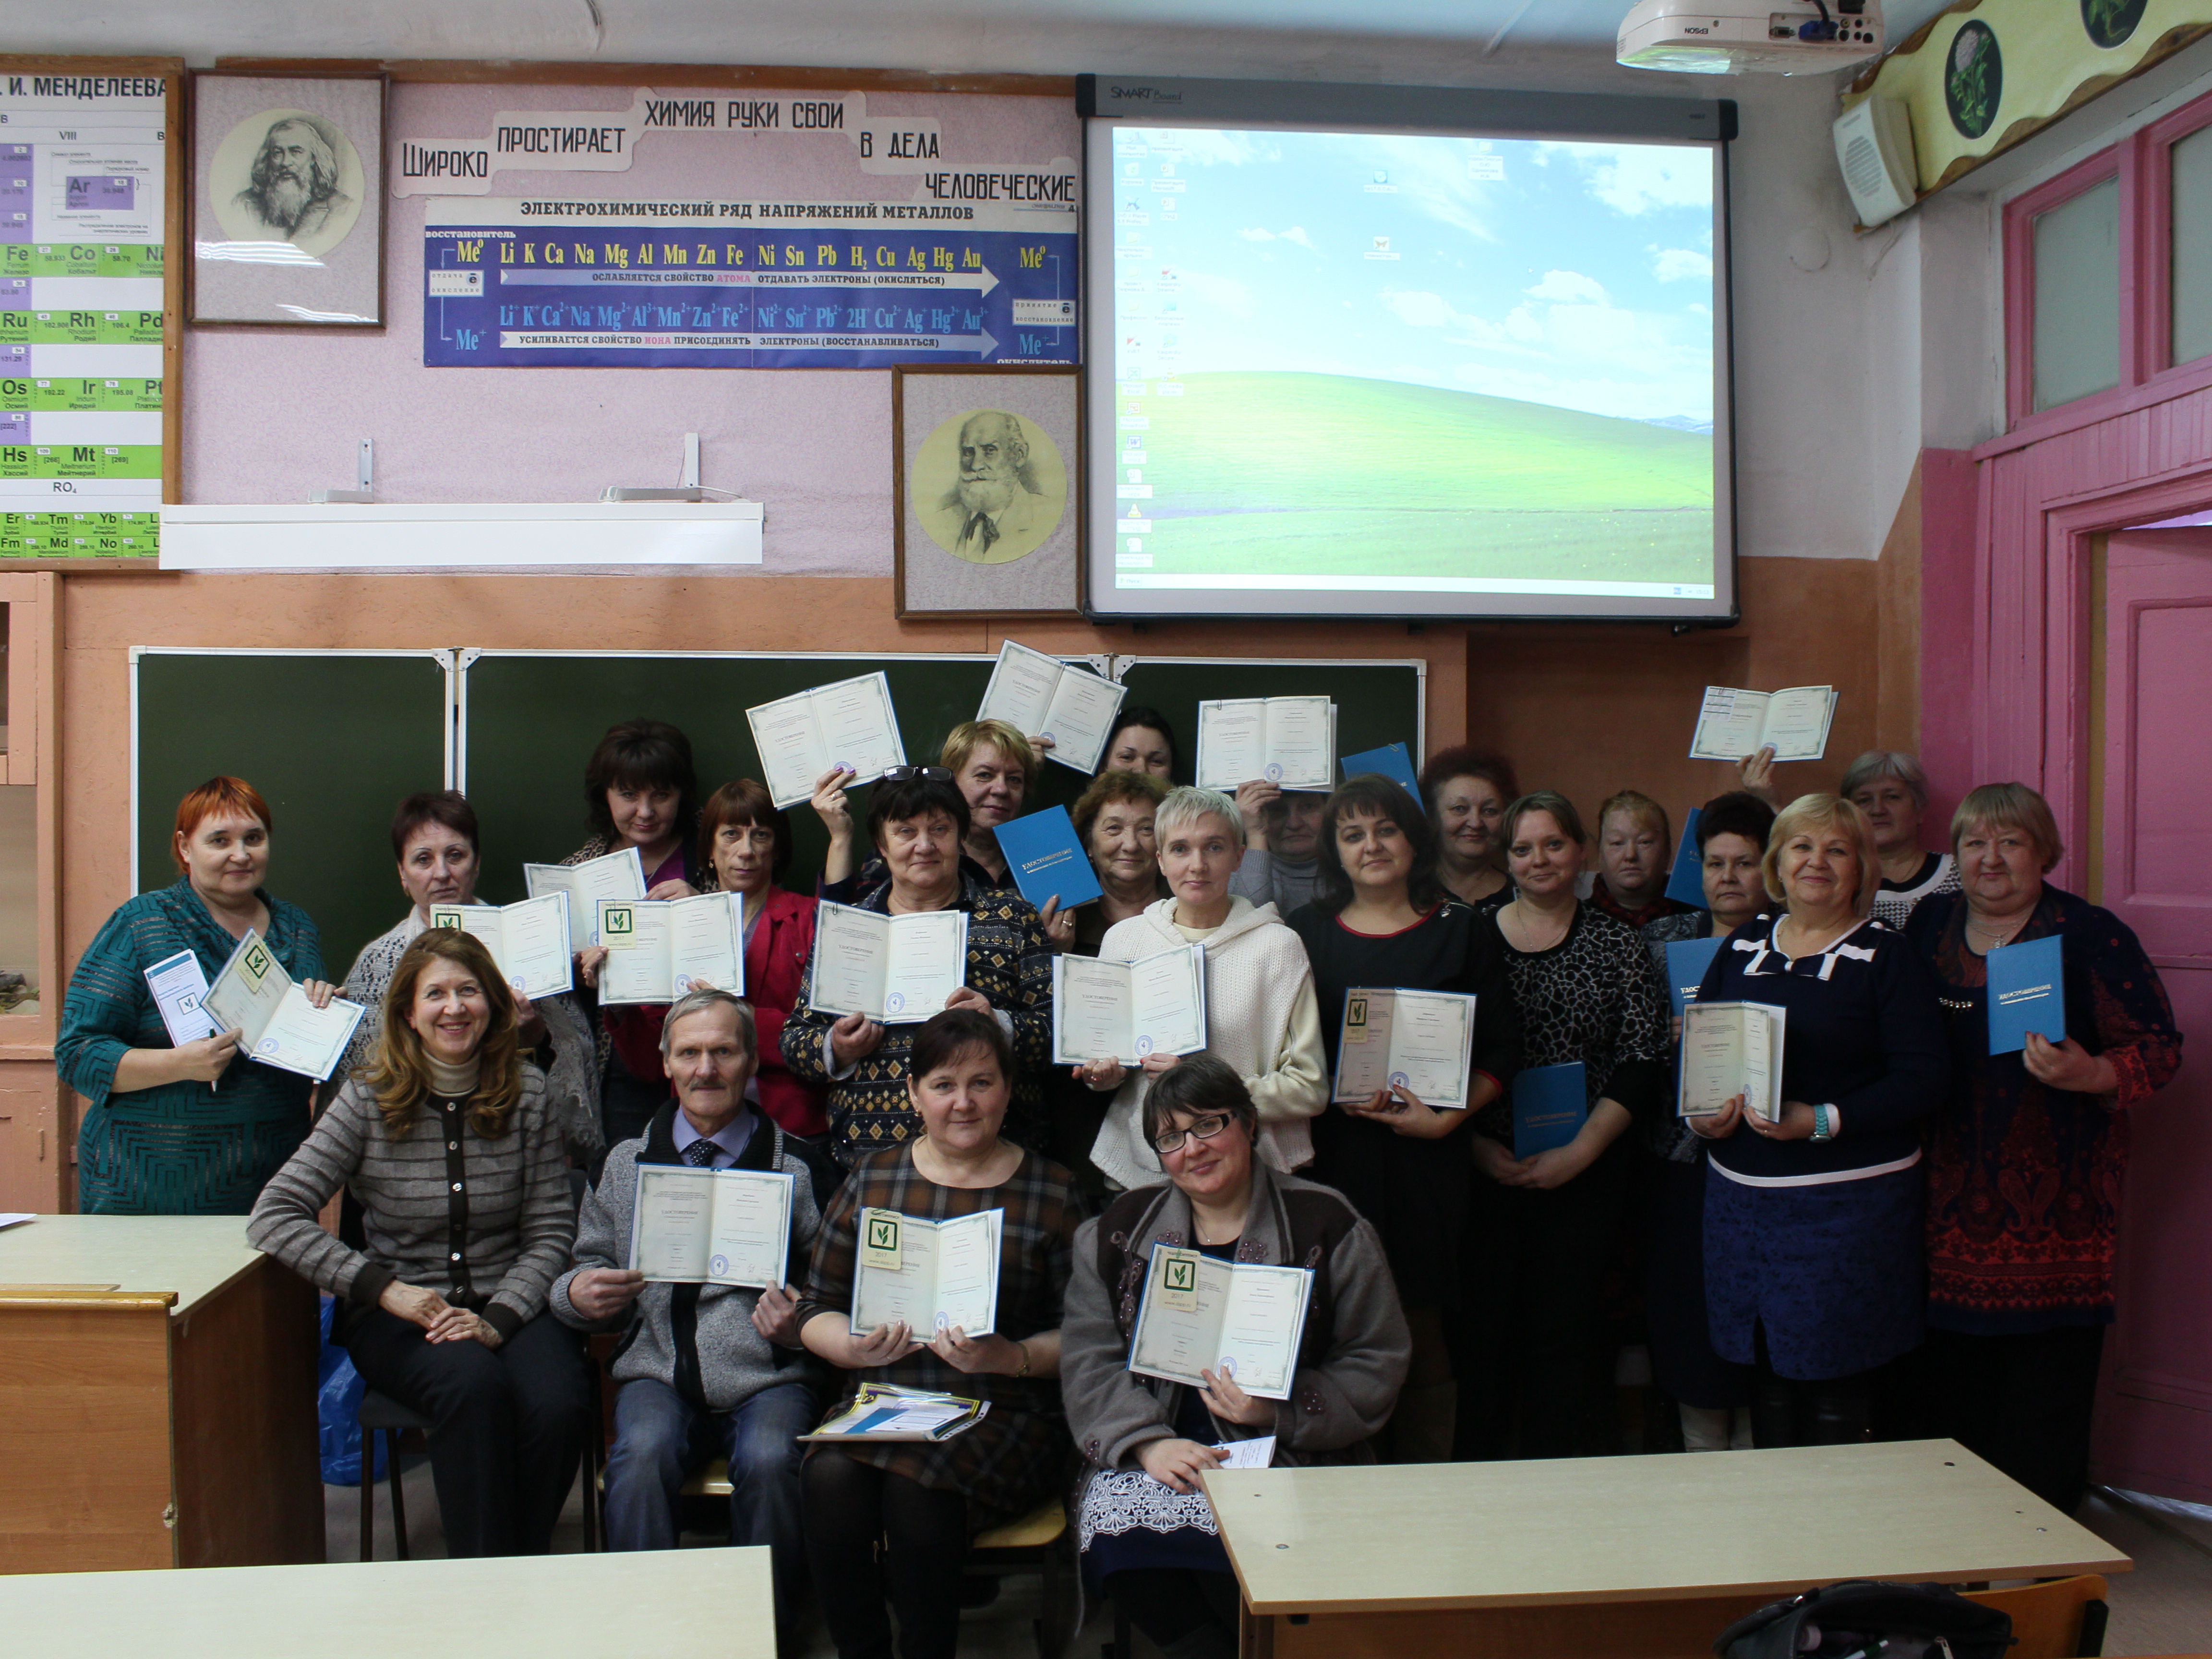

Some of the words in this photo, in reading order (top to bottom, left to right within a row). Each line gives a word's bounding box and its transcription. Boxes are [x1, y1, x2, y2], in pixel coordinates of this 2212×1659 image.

[9, 77, 27, 96] И.
[34, 77, 166, 100] МЕНДЕЛЕЕВА
[1110, 86, 1154, 99] SMART
[644, 99, 715, 127] ХИМИЯ
[728, 102, 779, 128] РУКИ
[792, 102, 843, 129] СВОИ
[59, 131, 77, 140] VIII
[497, 127, 626, 153] ПРОСТИРАЕТ
[861, 132, 873, 158] В
[888, 132, 939, 158] ДЕЛА
[403, 143, 488, 179] ШИРОКО
[69, 178, 90, 193] Ar
[926, 173, 1076, 202] ЧЕЛОВЕЧЕСКИЕ
[520, 200, 714, 217] ЭЛЕКТРОХИМИЧЕСКИЙ
[720, 204, 752, 219] РЯД
[759, 202, 878, 219] НАПРЯЖЕНИЙ
[882, 204, 974, 220] МЕТАЛЛОВ
[425, 230, 516, 239] восстановитель
[7, 246, 29, 261] Fe
[71, 245, 96, 261] Co
[146, 247, 164, 261] Ni
[501, 242, 515, 264] Li
[524, 243, 536, 264] K
[544, 242, 564, 264] Ca
[574, 243, 595, 264] Na
[605, 243, 629, 268] Mg
[637, 243, 653, 264] Al
[663, 244, 687, 264] Mn
[697, 244, 717, 264] Zn
[726, 244, 744, 265] Fe
[758, 244, 776, 265] Ni
[785, 245, 805, 266] Sn
[817, 244, 838, 266] Pb
[876, 246, 896, 267] Cu
[906, 246, 926, 271] Ag
[933, 247, 954, 272] Hg
[962, 247, 982, 267] Au
[592, 273, 661, 282] ОСЛАБЛЯЕТСЯ
[664, 272, 714, 282] СВОЙСТВО
[716, 274, 751, 283] АТОМА
[757, 275, 809, 285] ОТДАВАТЬ
[812, 275, 872, 284] ЭЛЕКТРОНЫ
[873, 276, 945, 286] (ОКИСЛЯТЬСЯ)
[3, 313, 28, 328] Ru
[71, 313, 95, 328] Rh
[140, 313, 163, 328] Pd
[519, 336, 589, 345] УСИЛИВАЕТСЯ
[591, 334, 642, 345] СВОЙСТВО
[674, 337, 751, 346] ПРИСОЕДИНЯТЬ
[760, 337, 819, 346] ЭЛЕКТРОНЫ
[821, 337, 939, 349] (ВОССТАНАВЛИВАТЬСЯ)
[2, 380, 27, 395] Os
[83, 380, 96, 395] Ir
[145, 380, 162, 395] Pt
[3, 447, 27, 462] Hs
[73, 447, 95, 462] Mt
[6, 514, 20, 524] Er
[49, 514, 69, 524] Tm
[100, 513, 117, 523] Yb
[150, 514, 160, 523] L
[1, 538, 20, 548] Fm
[50, 538, 69, 548] Md
[100, 539, 117, 548] No
